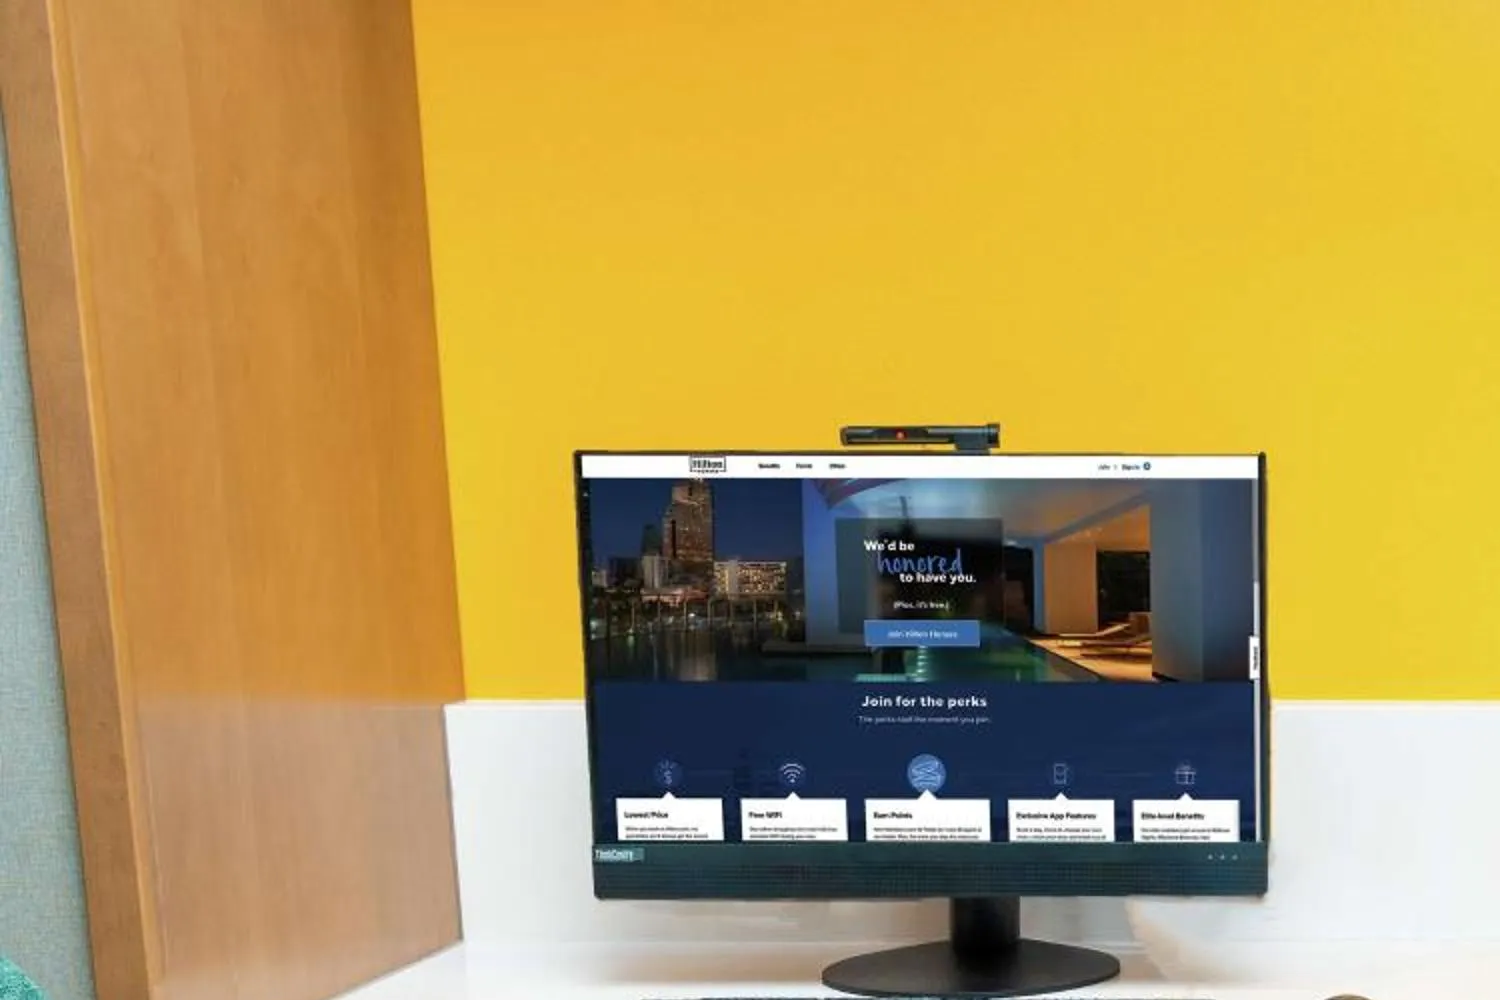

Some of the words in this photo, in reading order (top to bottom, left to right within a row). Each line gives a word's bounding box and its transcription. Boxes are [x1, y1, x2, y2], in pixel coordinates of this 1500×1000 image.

[692, 458, 723, 469] Hilton
[863, 539, 896, 551] We'd
[898, 540, 915, 551] be
[876, 547, 962, 576] honored
[899, 573, 914, 583] to
[916, 573, 947, 583] have
[950, 574, 977, 585] you.
[861, 695, 893, 707] Join
[895, 695, 916, 707] for
[920, 696, 944, 707] the
[947, 695, 987, 709] perks
[1050, 812, 1064, 820] App
